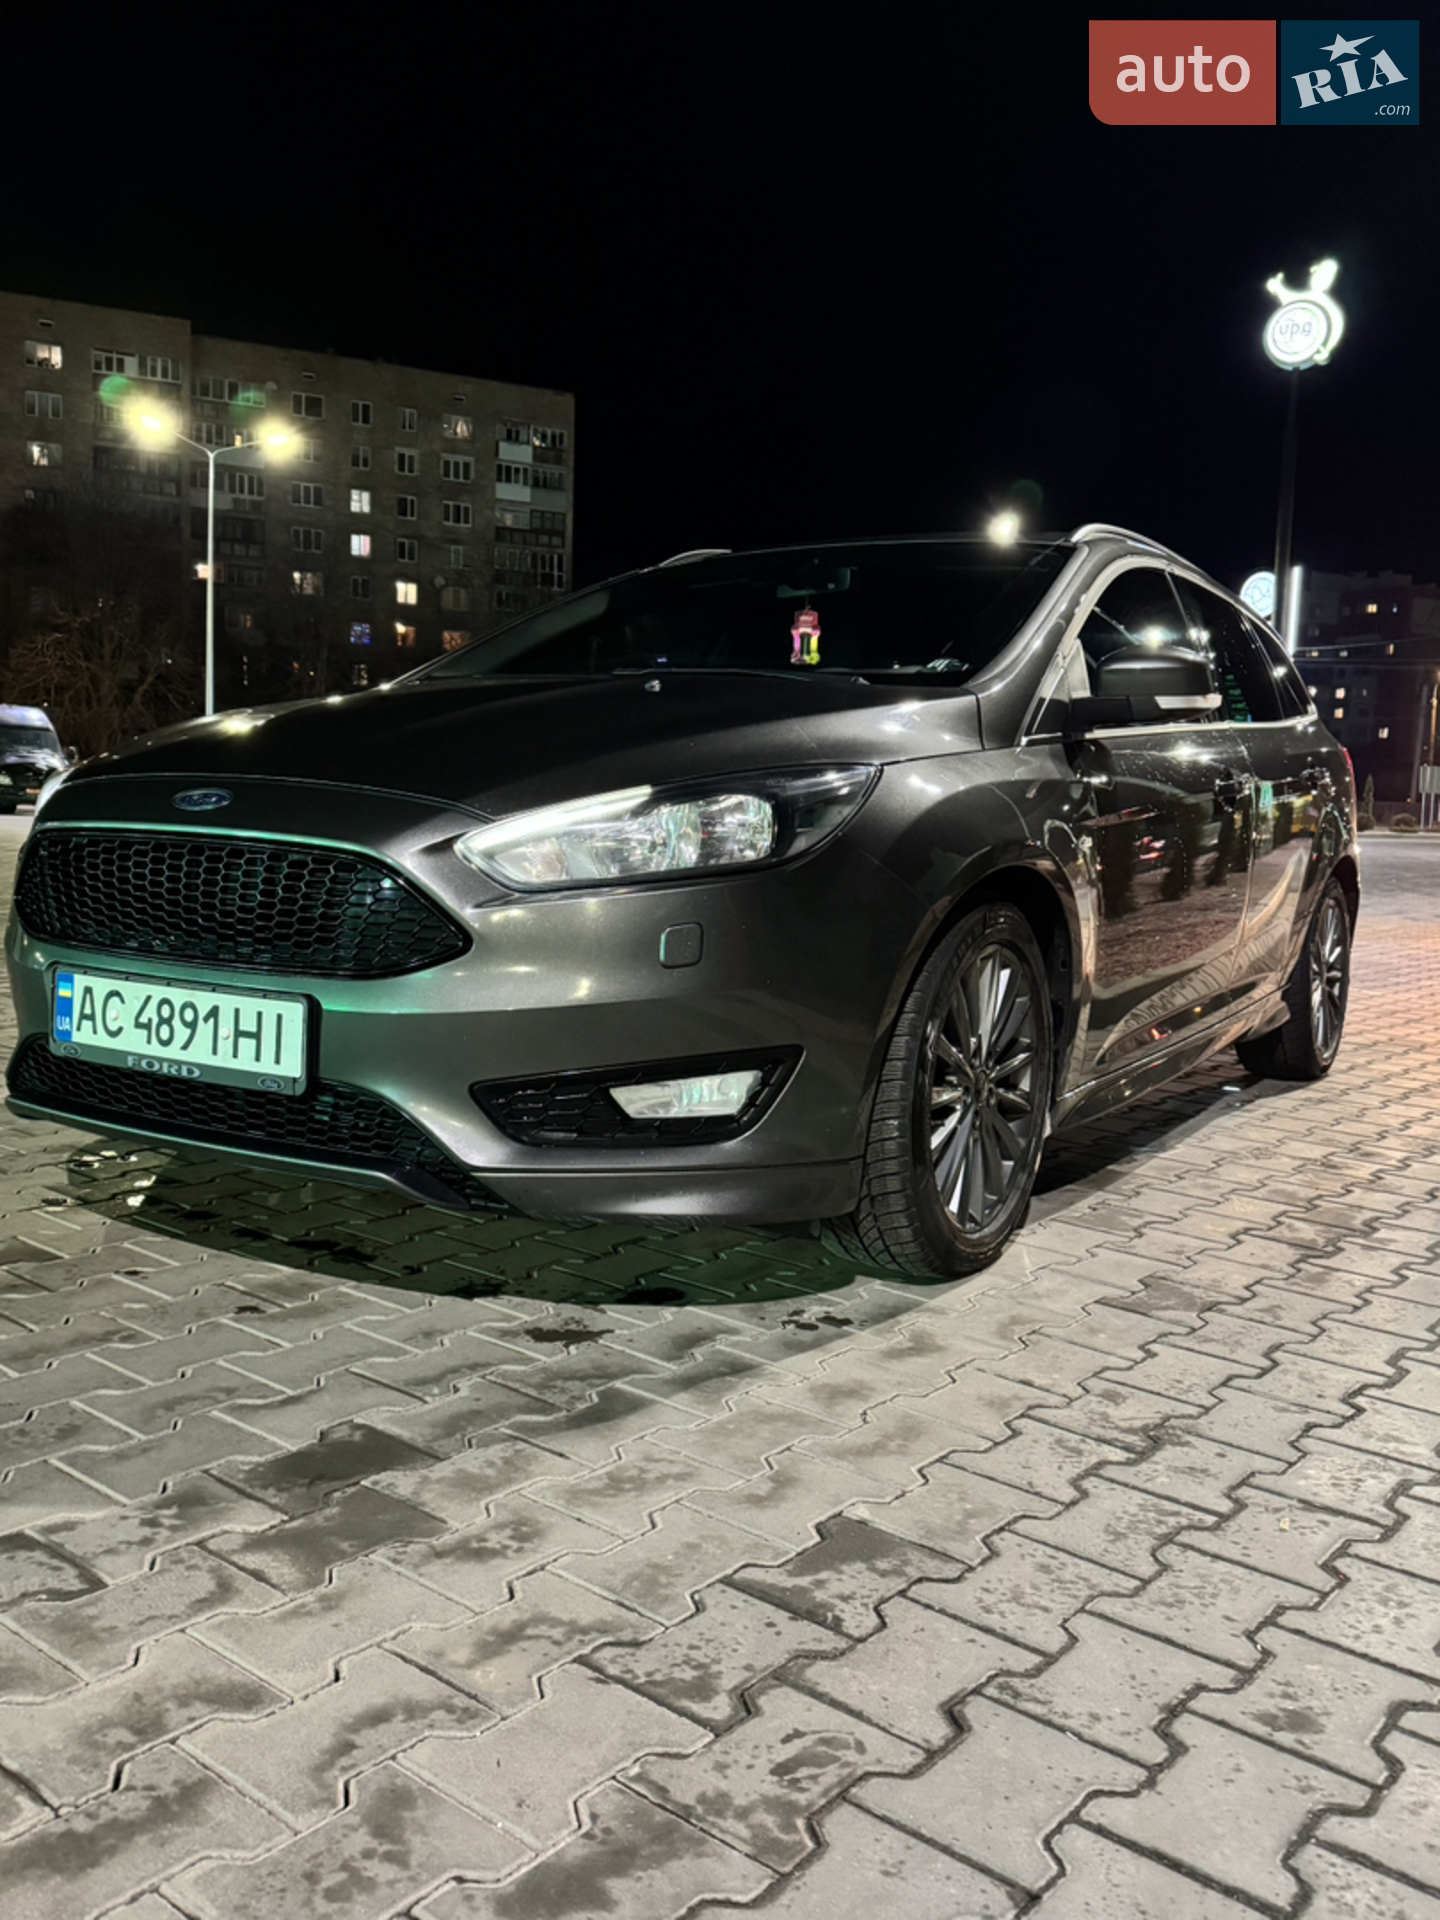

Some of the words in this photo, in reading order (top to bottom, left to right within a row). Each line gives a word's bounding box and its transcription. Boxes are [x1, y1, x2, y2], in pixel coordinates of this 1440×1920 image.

[56, 1014, 71, 1032] UA
[76, 985, 125, 1038] AC
[133, 994, 220, 1056] 4891
[232, 1007, 284, 1065] HI
[127, 1055, 202, 1079] FORD
